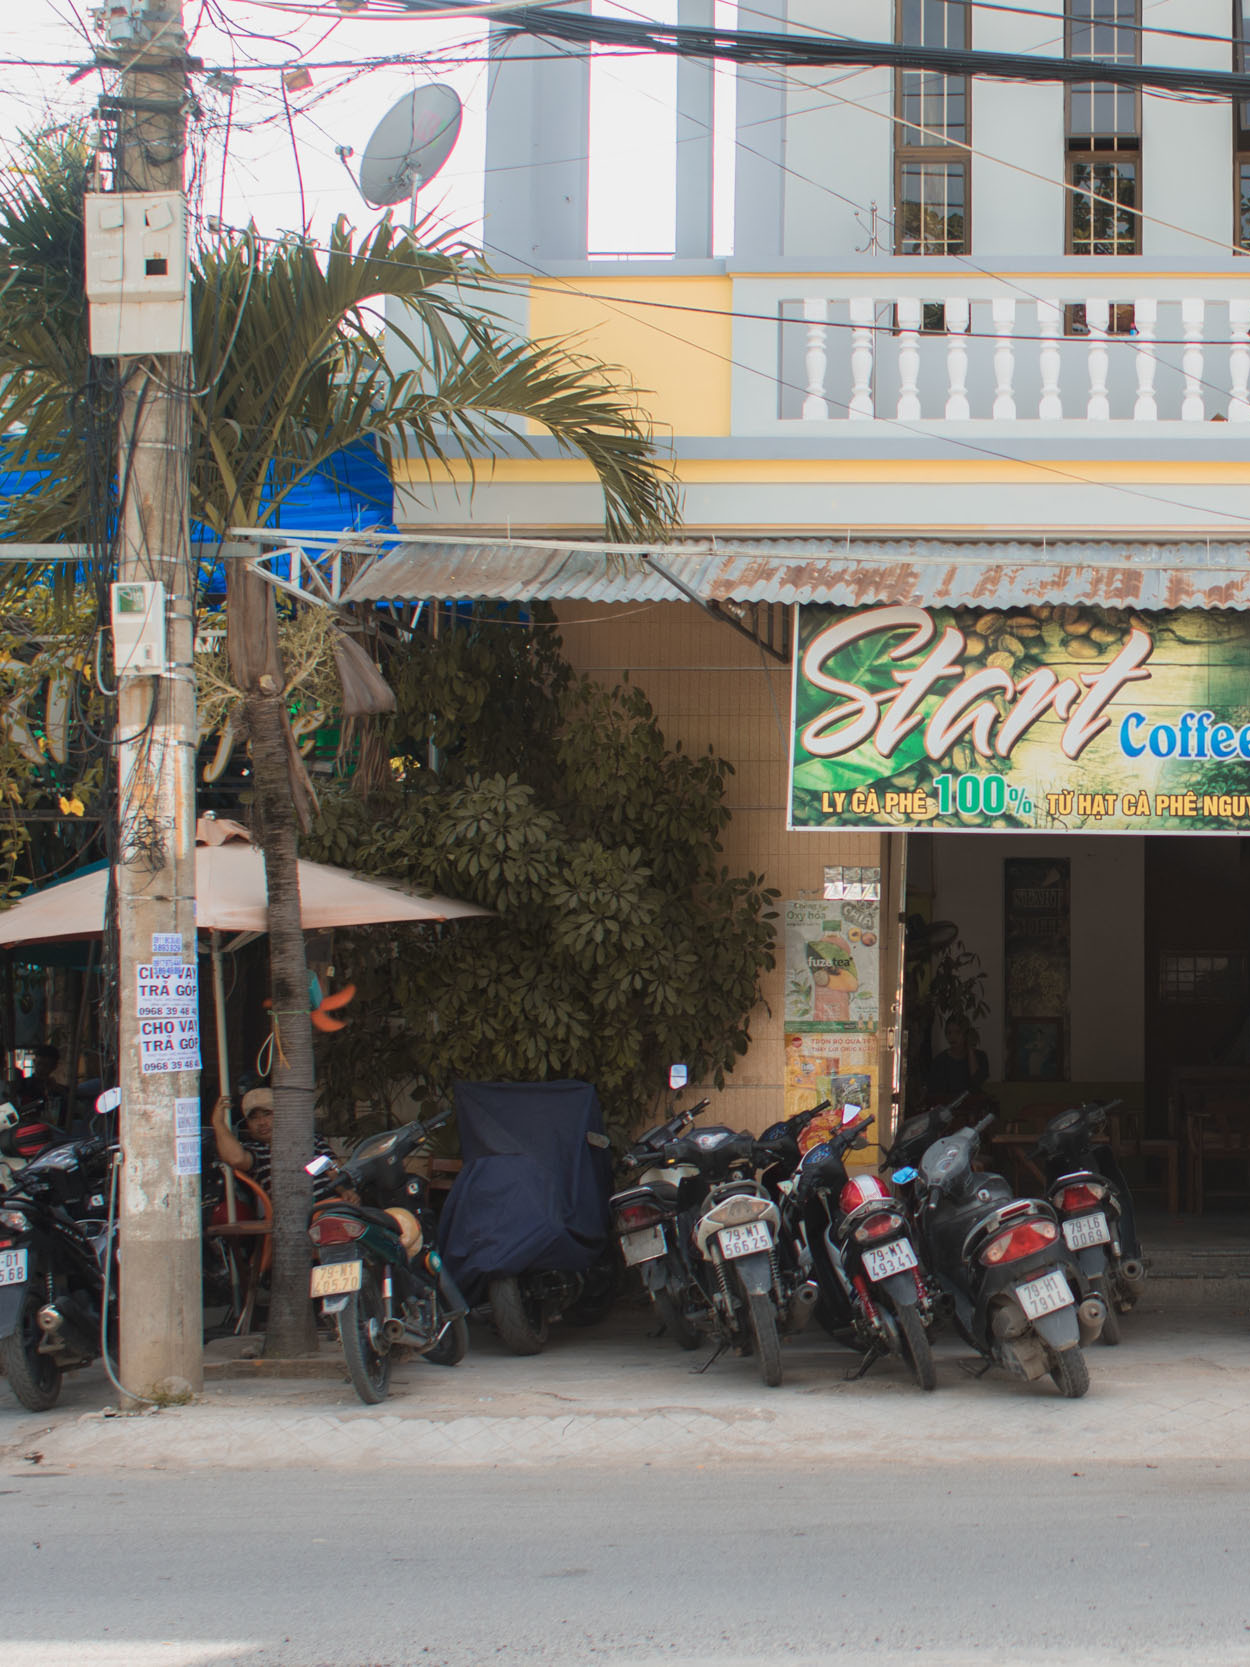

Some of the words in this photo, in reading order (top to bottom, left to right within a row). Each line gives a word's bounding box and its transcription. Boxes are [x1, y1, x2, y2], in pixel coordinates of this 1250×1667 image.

[801, 605, 1153, 760] Start
[821, 792, 845, 813] LY
[851, 788, 879, 813] CÀ
[886, 788, 927, 813] PHÊ
[933, 774, 1033, 815] 100%
[1047, 789, 1074, 816] TỪ
[1077, 794, 1117, 820] HẠT
[1122, 789, 1150, 816] CÀ
[1155, 791, 1198, 816] PHÊ
[140, 981, 170, 997] TRẢ
[166, 1007, 178, 1015] 39
[142, 1021, 175, 1035] CHO
[143, 1035, 174, 1052] TRẢ
[172, 1062, 182, 1070] 39
[1069, 1217, 1101, 1235] 79-L6
